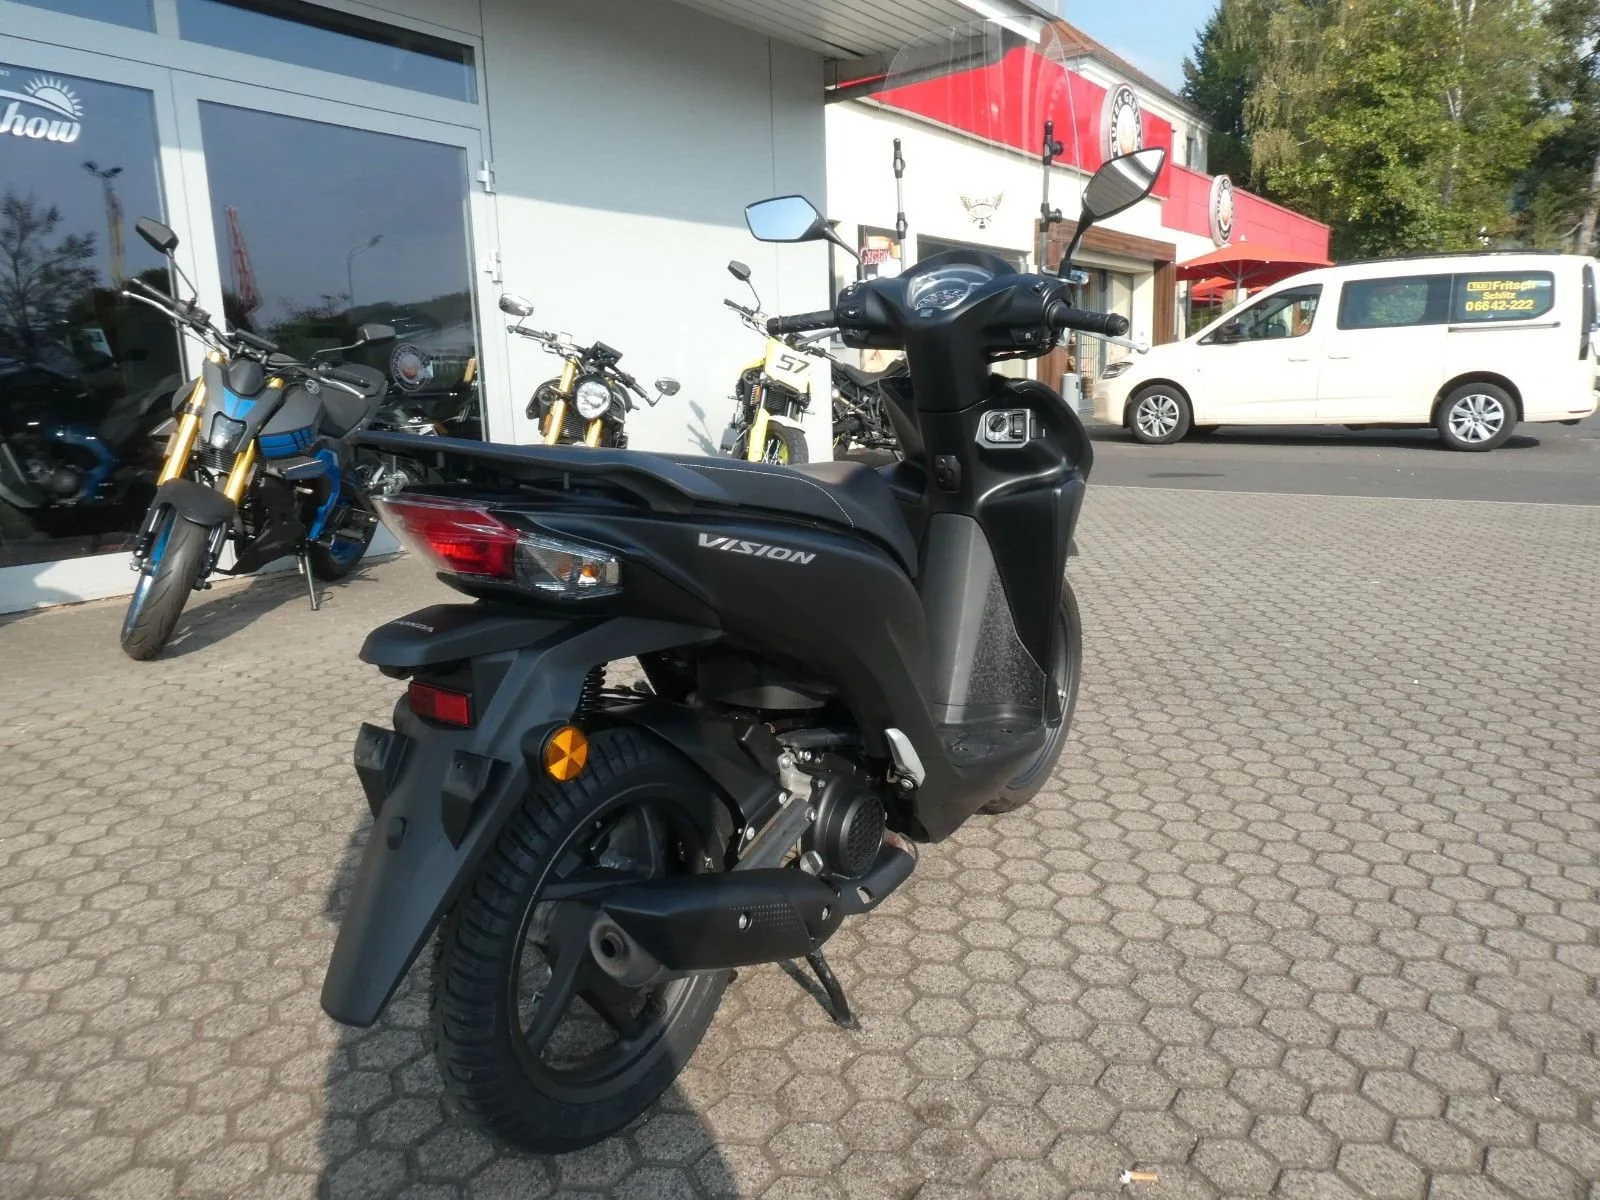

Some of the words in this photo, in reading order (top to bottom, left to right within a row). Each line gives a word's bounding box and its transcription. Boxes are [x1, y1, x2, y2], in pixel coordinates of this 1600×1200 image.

[0, 101, 81, 143] how
[1111, 95, 1123, 153] GUTER
[1482, 291, 1516, 300] Schlitz
[1492, 280, 1536, 291] Fritsch
[775, 353, 810, 374] 57
[698, 533, 817, 565] VISION
